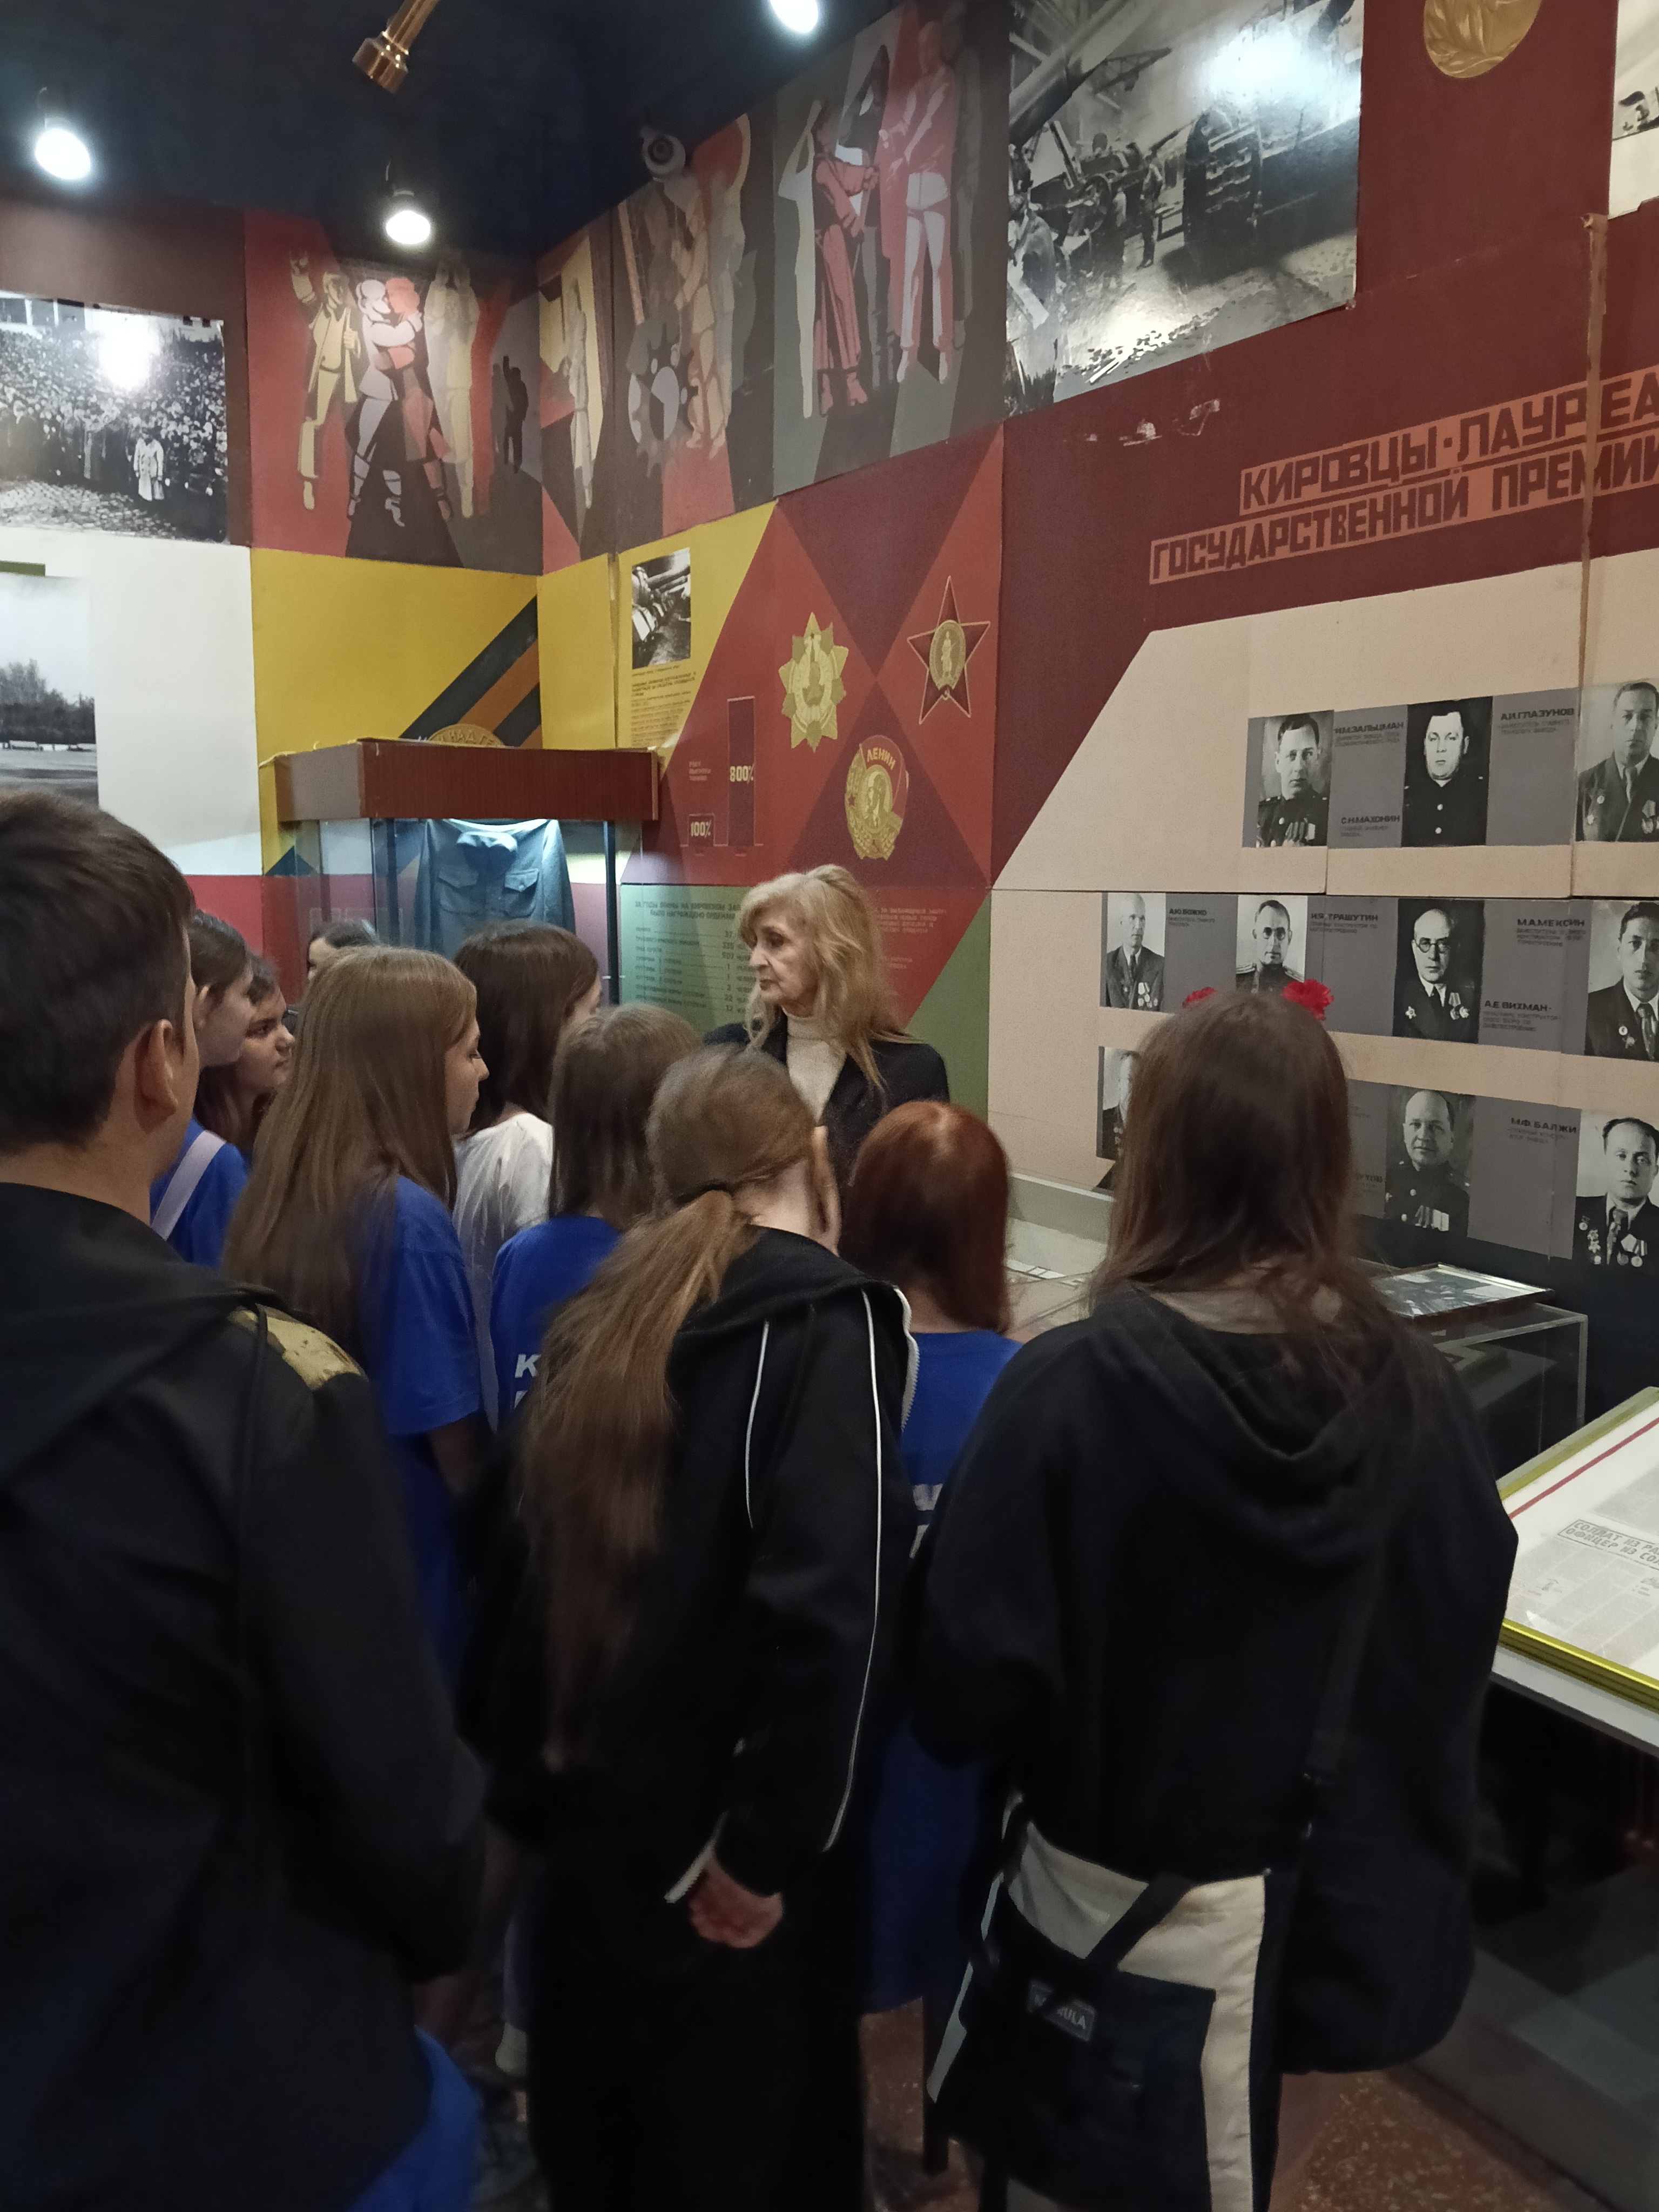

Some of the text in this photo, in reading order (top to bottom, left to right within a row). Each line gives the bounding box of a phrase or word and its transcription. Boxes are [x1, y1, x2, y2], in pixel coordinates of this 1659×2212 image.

[1153, 468, 1469, 579] ГОСУДАРСТВЕННОЙ
[867, 747, 896, 770] ЛЕНИН
[730, 763, 754, 784] 800%
[691, 820, 712, 839] 100%
[1566, 1527, 1619, 1548] ОФИЦЕР
